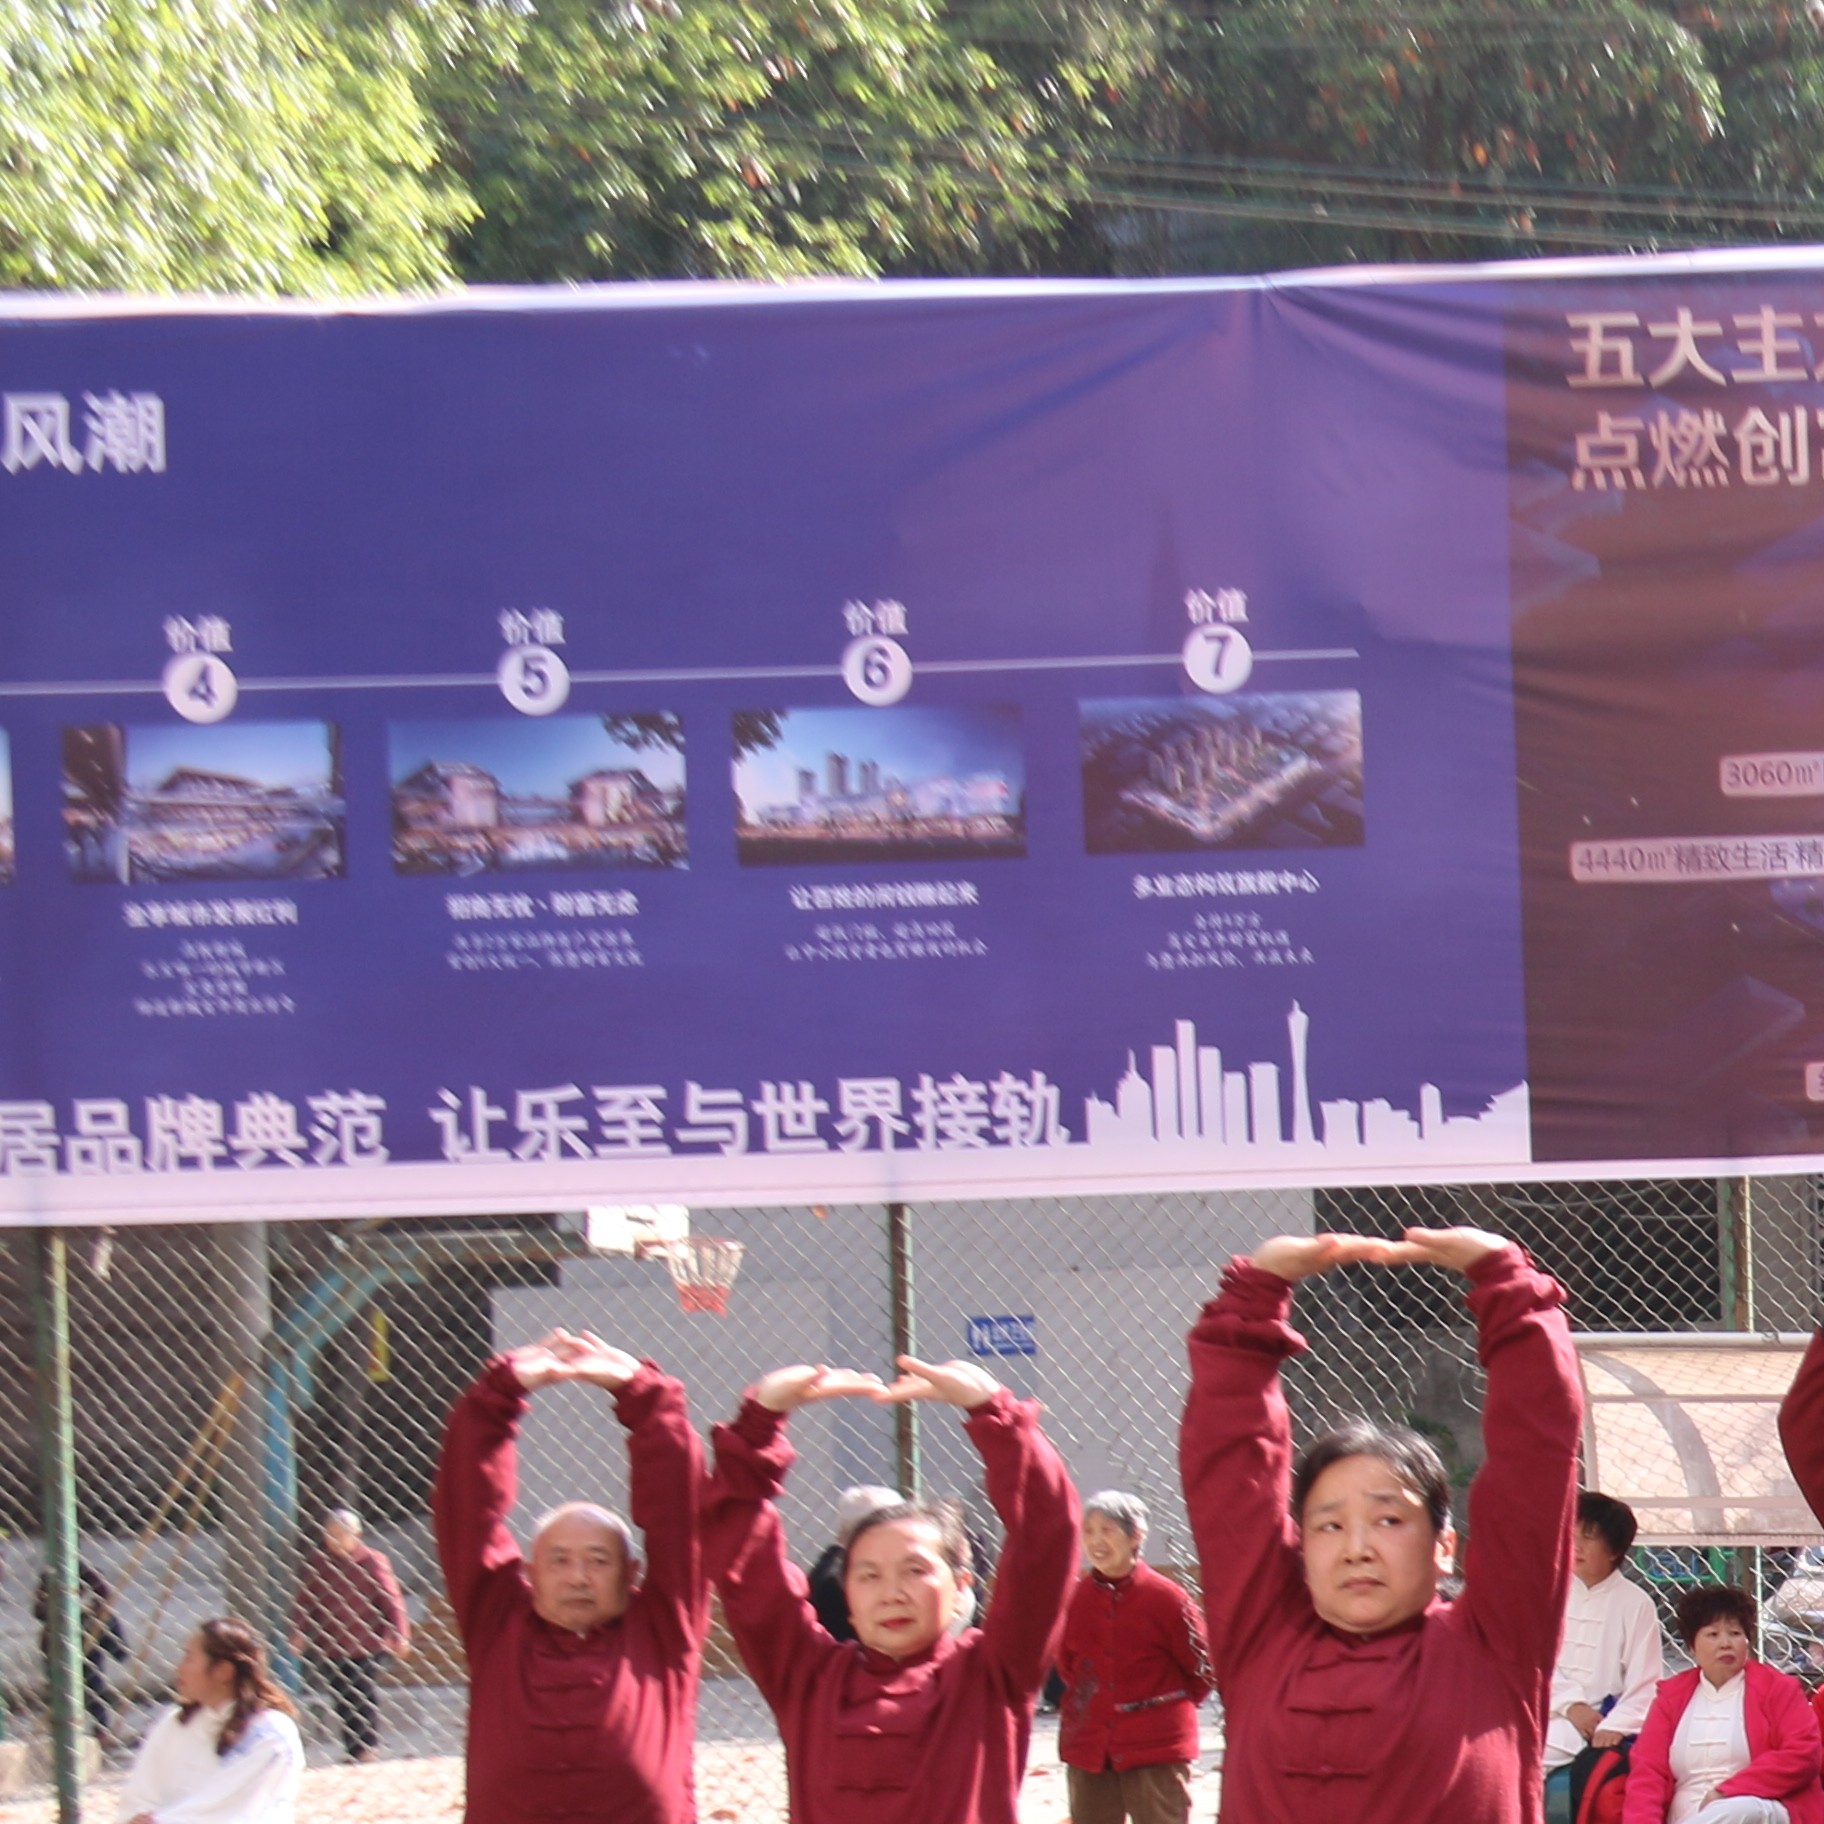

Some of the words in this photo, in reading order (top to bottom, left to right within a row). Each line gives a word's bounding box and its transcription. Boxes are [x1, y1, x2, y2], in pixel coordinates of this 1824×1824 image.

[1, 387, 166, 475] 风潮
[499, 607, 566, 645] 价值
[843, 600, 907, 638] 价值
[1185, 588, 1248, 626] 价值
[163, 614, 233, 652] 价值
[1202, 632, 1230, 677] 7
[188, 664, 218, 709] 4
[520, 655, 551, 698] 5
[861, 646, 891, 689] 6
[0, 1088, 391, 1178] 居品牌典范
[428, 1069, 1071, 1164] 让乐至与世界接轨
